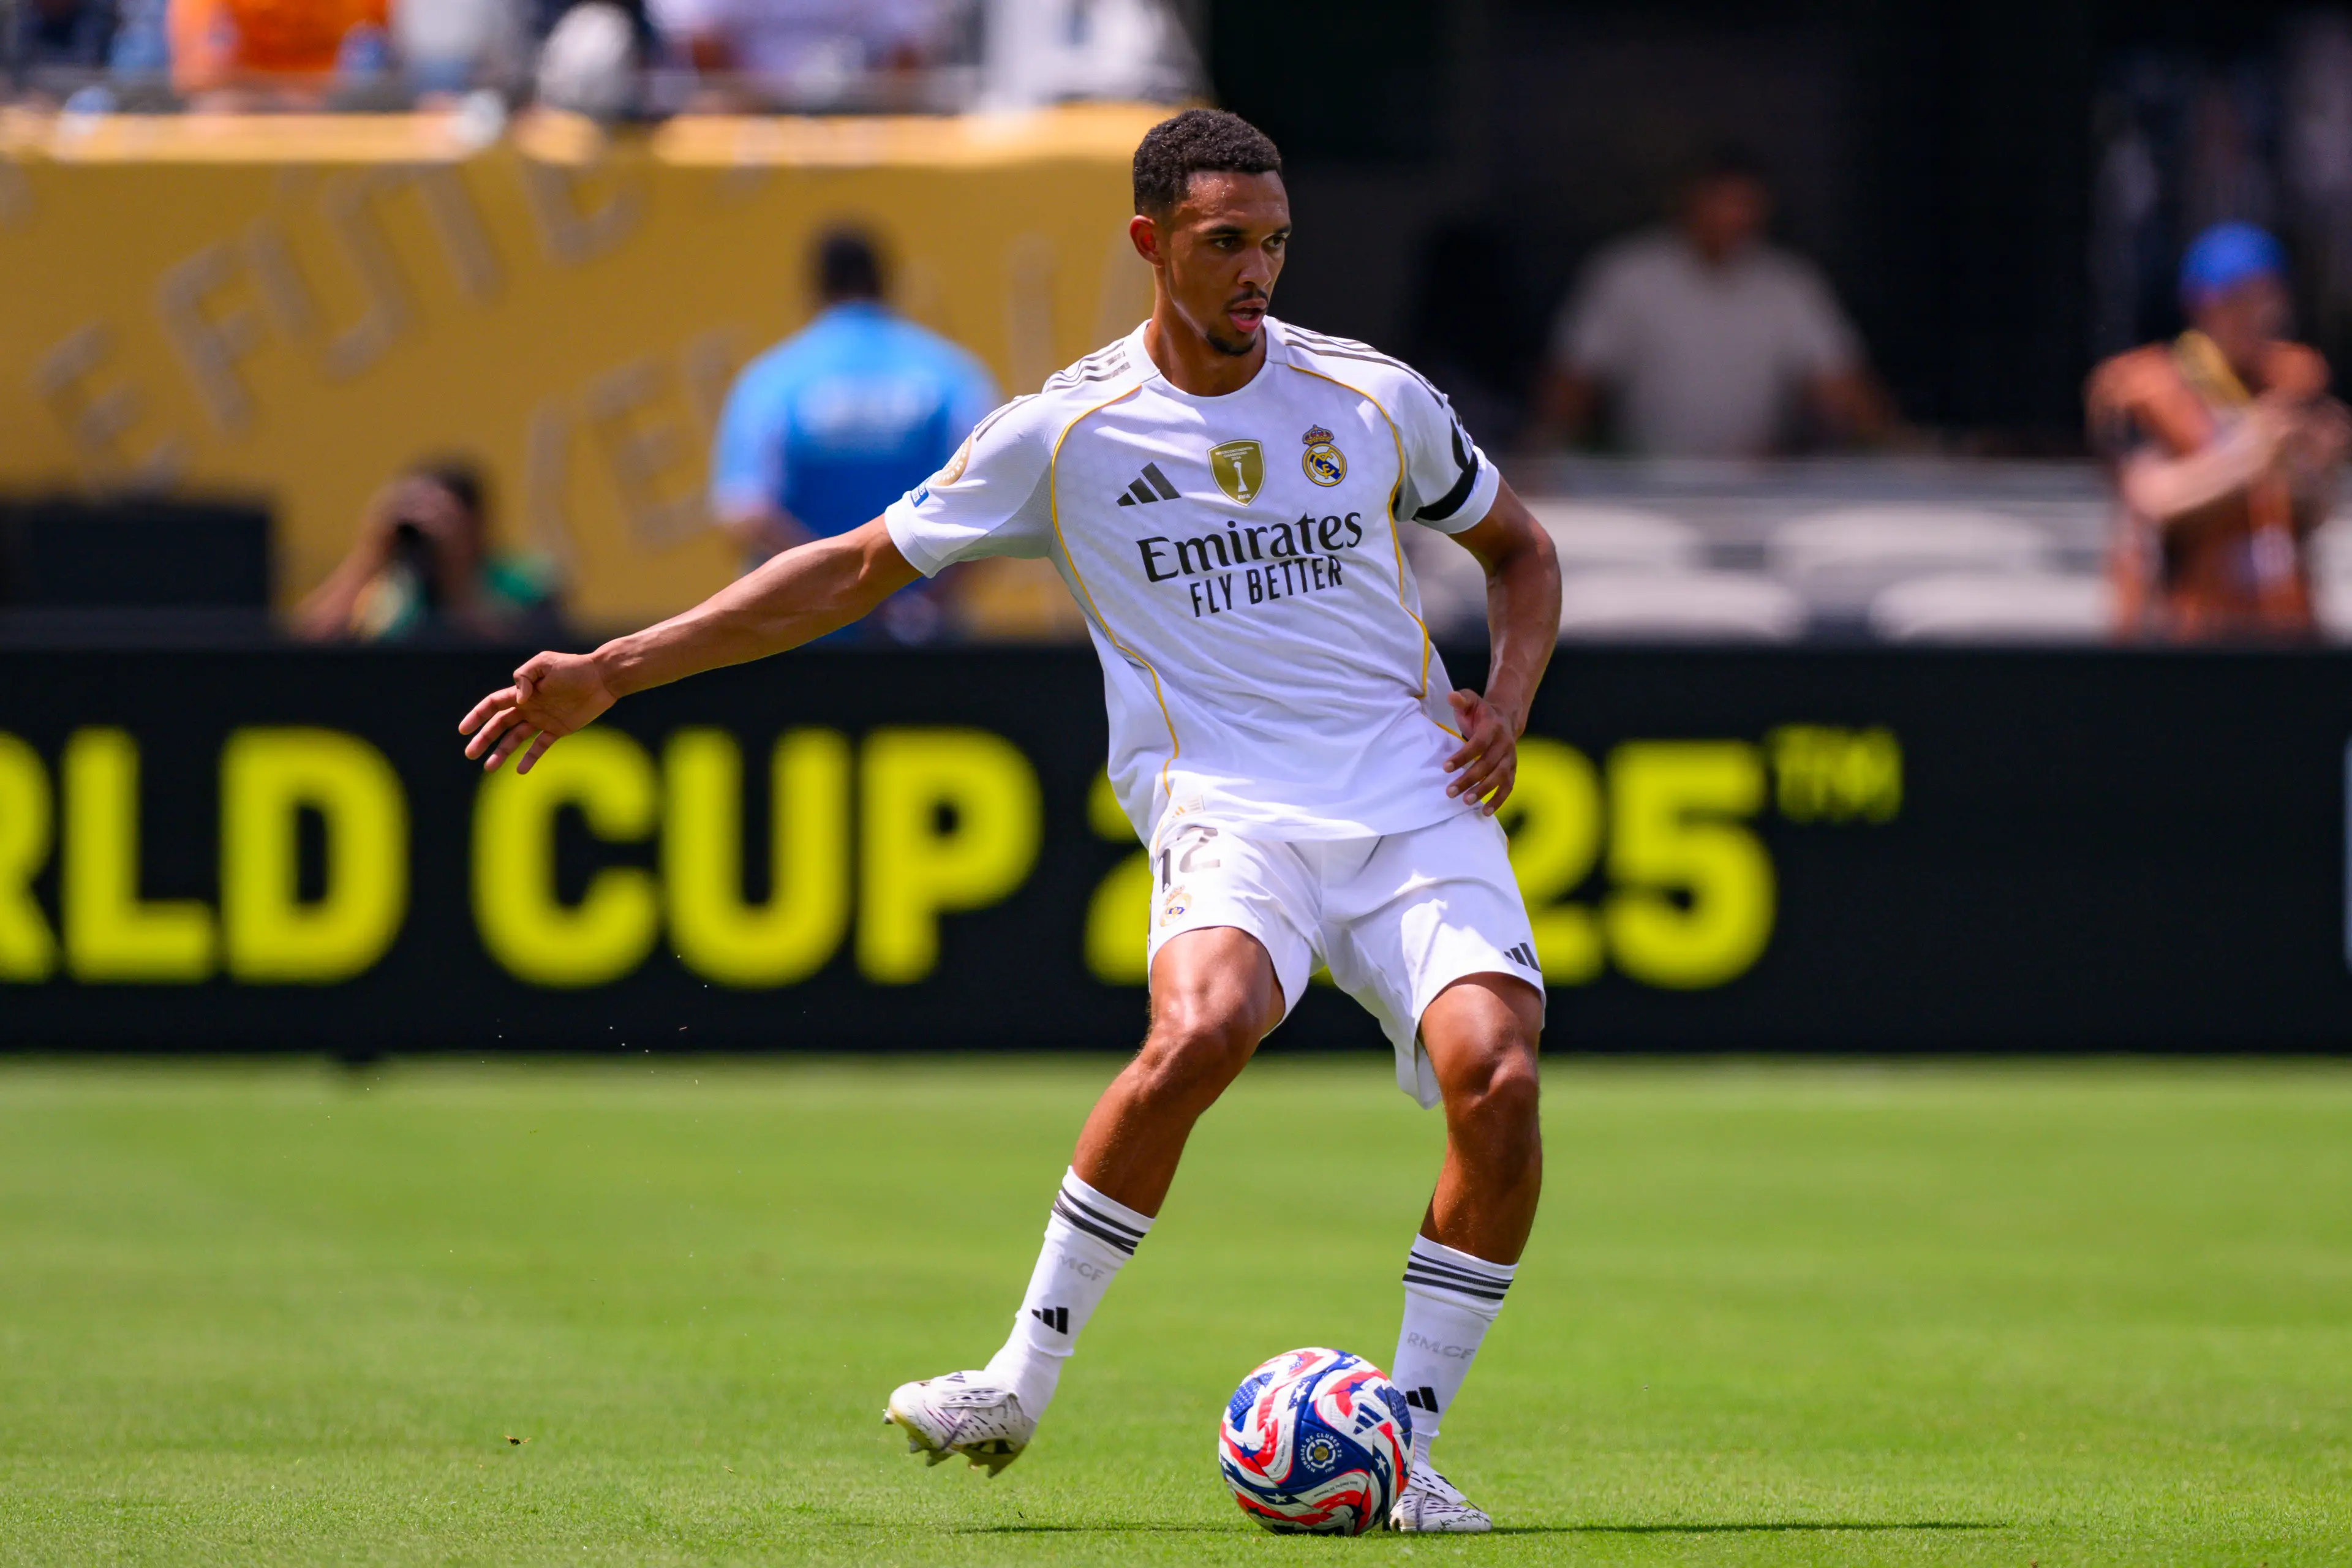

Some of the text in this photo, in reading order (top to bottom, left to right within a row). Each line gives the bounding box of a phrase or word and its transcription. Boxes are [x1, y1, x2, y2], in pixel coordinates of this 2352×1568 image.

[1136, 512, 1362, 582] Emirates
[1190, 554, 1343, 618] FLY BETTER
[470, 726, 1041, 987] CUP
